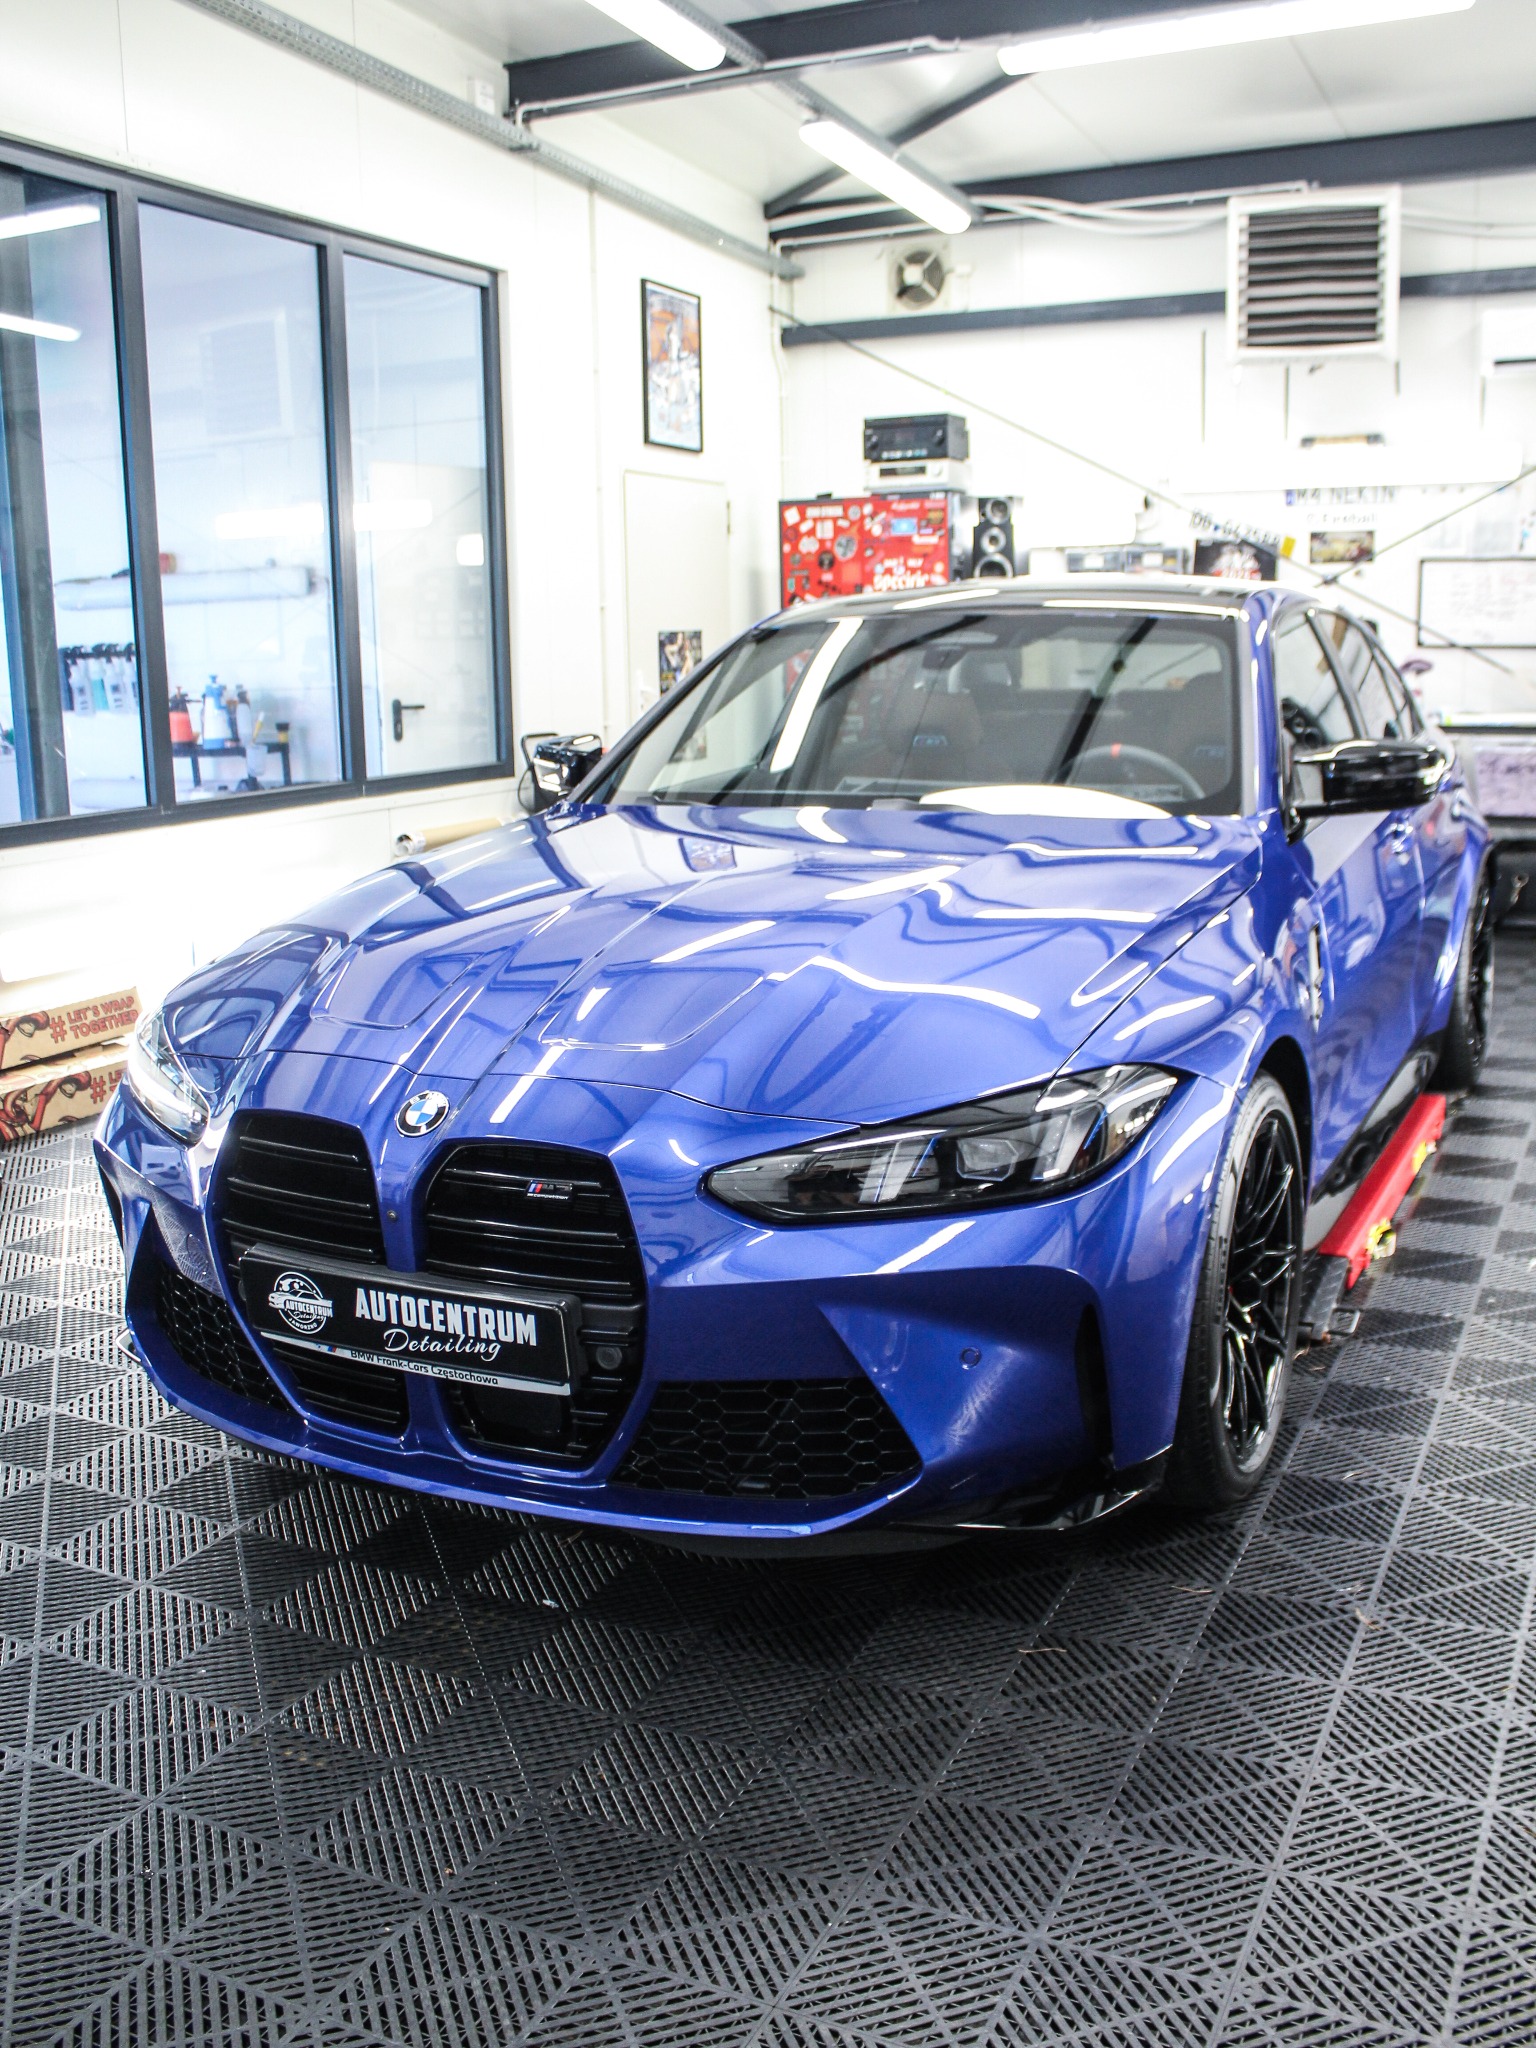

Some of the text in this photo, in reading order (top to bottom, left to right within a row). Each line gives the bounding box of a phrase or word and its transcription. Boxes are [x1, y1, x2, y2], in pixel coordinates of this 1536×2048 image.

[66, 995, 135, 1024] LET'S WRAP
[285, 1299, 333, 1318] AUTOCENTRUM
[288, 1318, 318, 1330] JAWORZNO
[355, 1287, 537, 1347] AUTOCENTRUM
[383, 1328, 501, 1362] Detailing
[350, 1350, 499, 1386] BMW Frank-Cars Częstochowa
